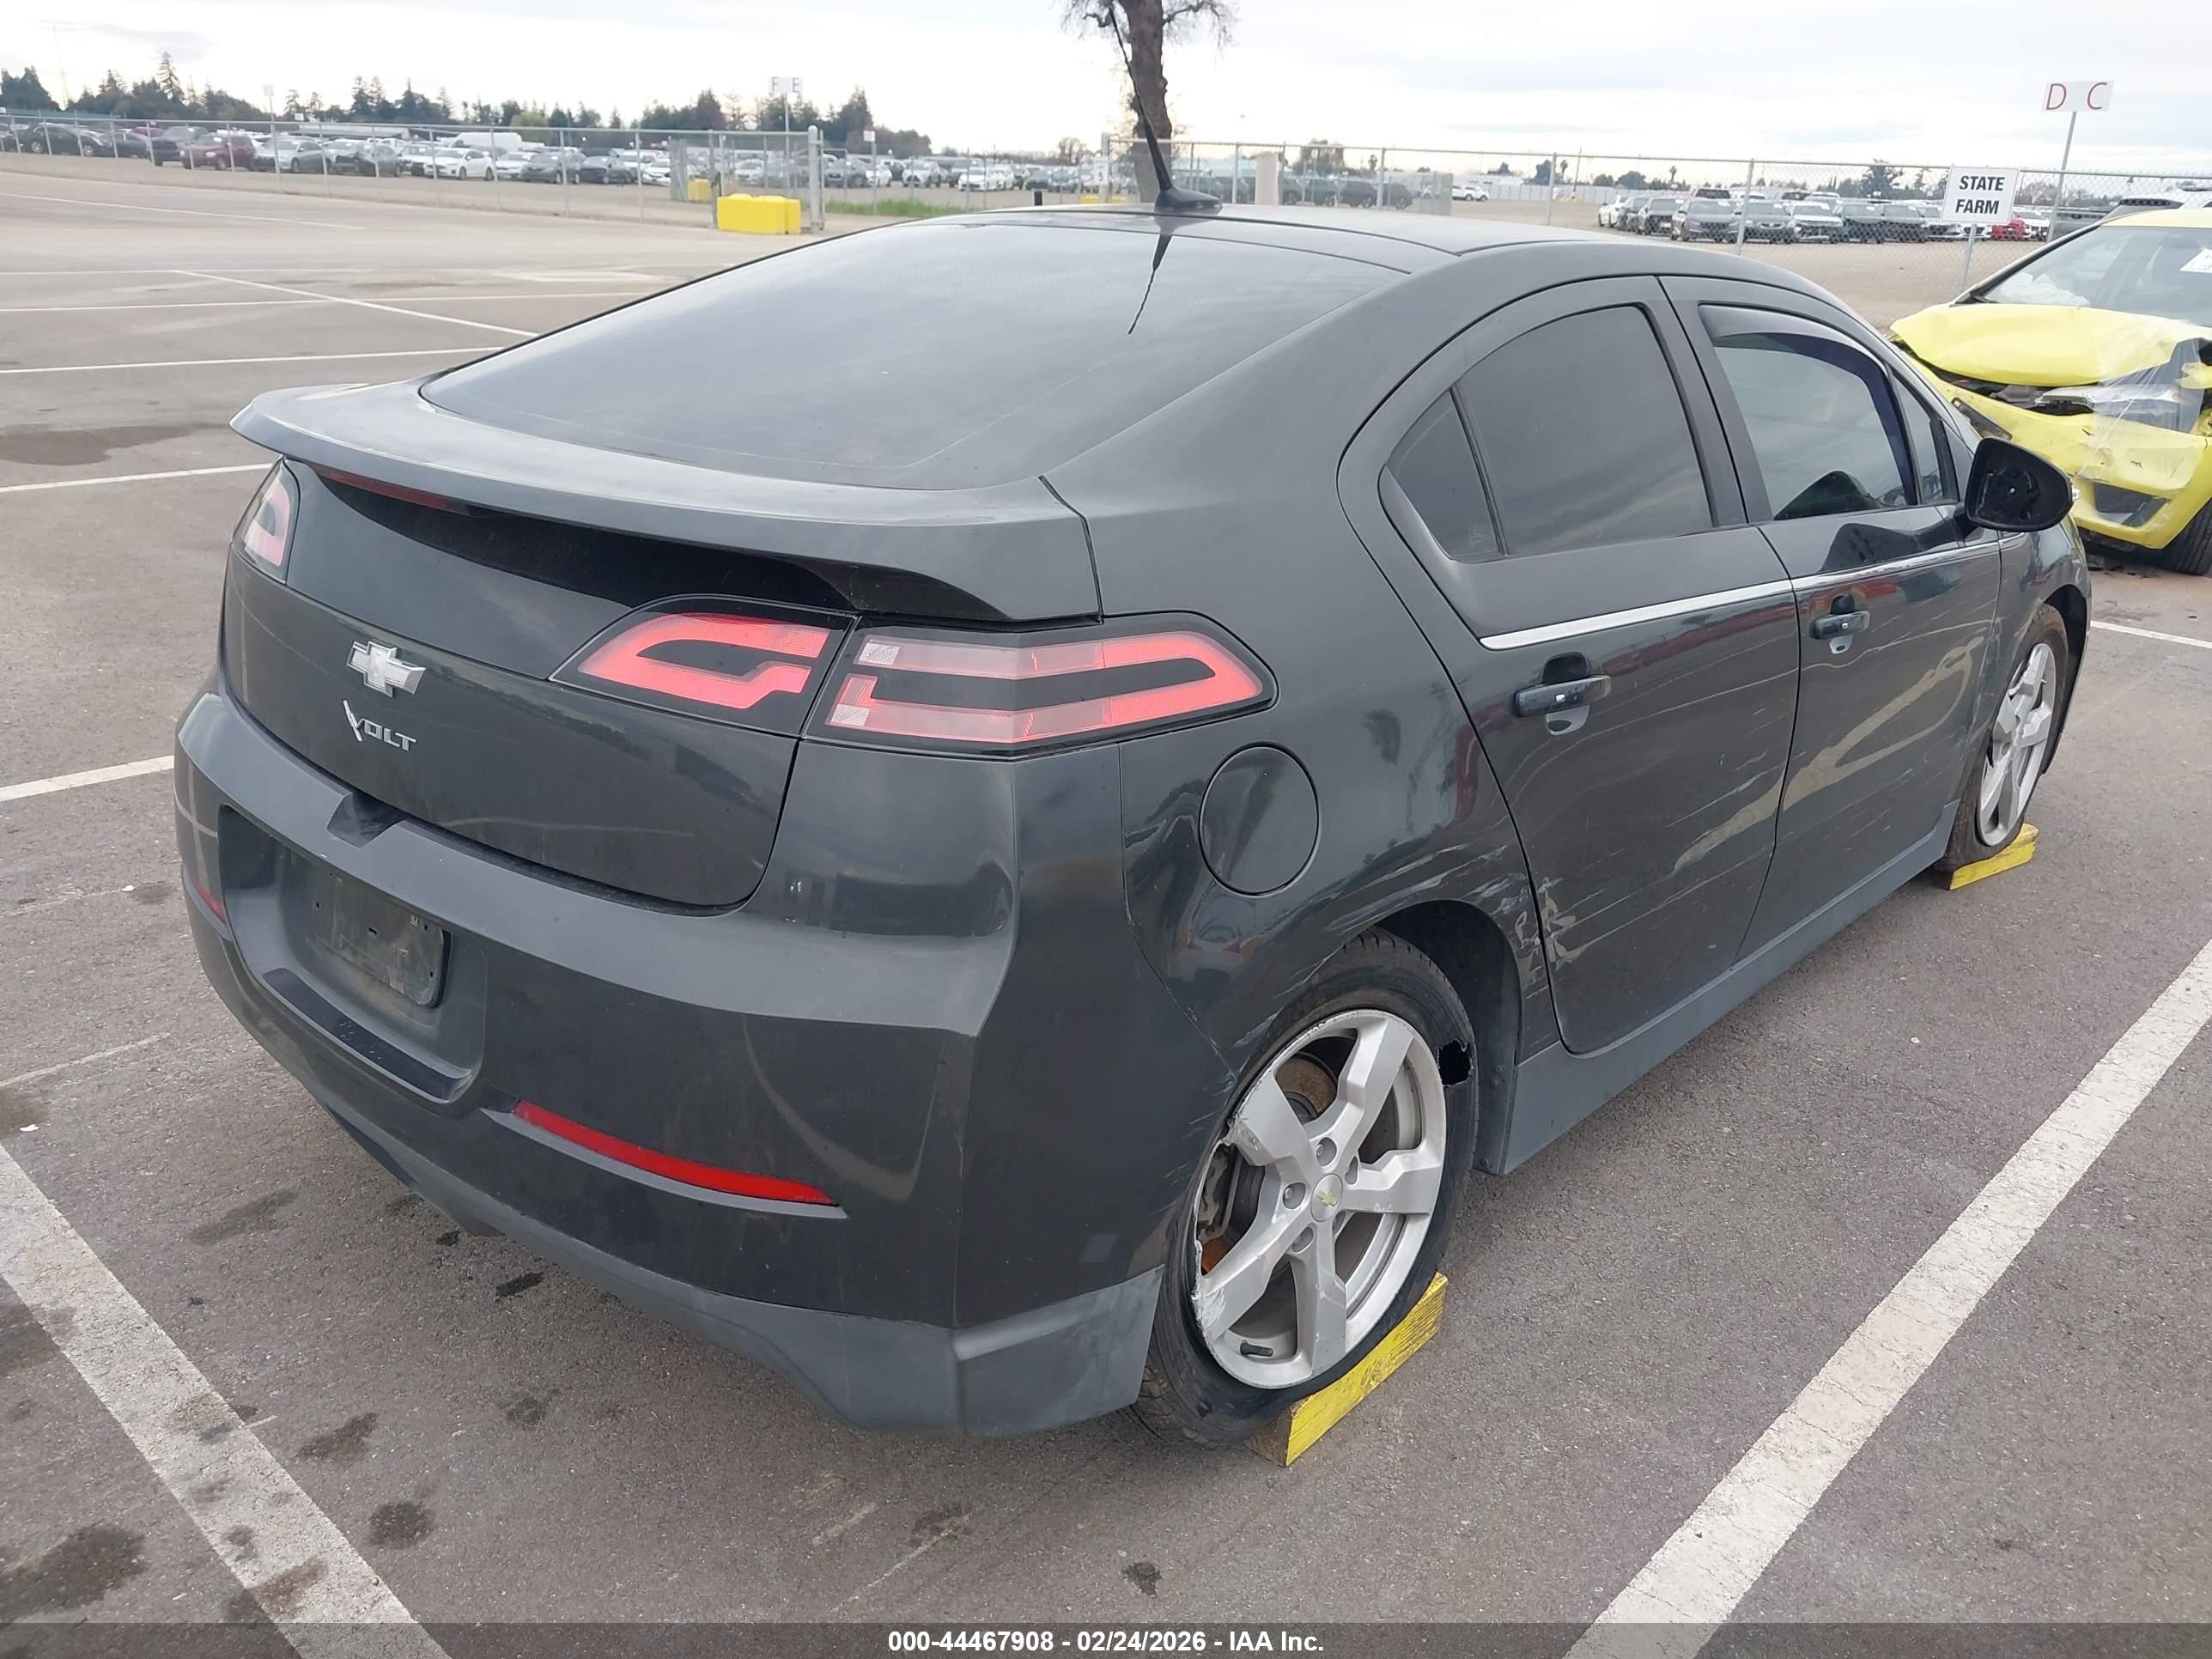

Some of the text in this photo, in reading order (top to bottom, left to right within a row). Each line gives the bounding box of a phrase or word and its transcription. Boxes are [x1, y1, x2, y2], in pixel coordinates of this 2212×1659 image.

[2046, 82, 2107, 110] D C
[1960, 176, 2004, 191] STATE
[1956, 199, 1999, 214] FARM
[343, 700, 416, 750] VOLT
